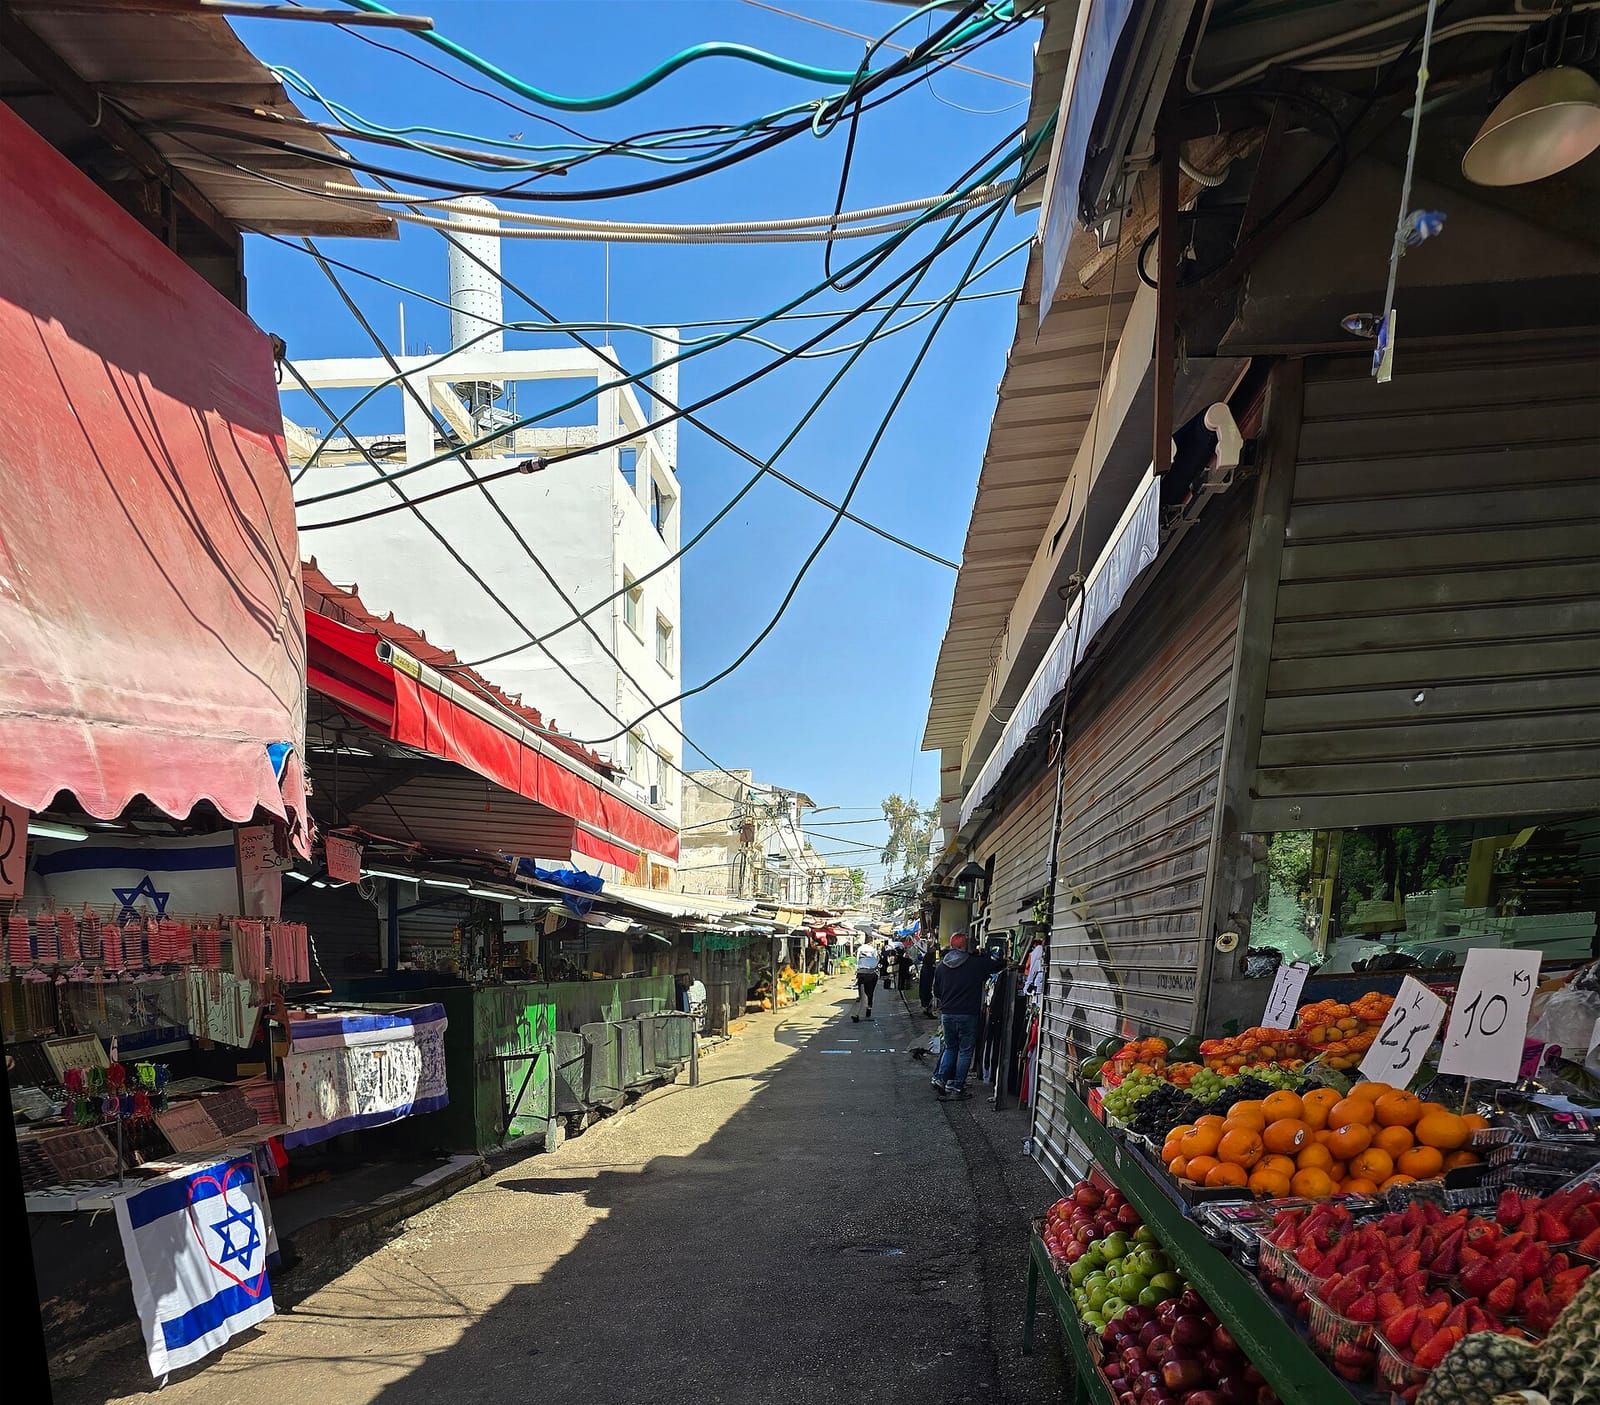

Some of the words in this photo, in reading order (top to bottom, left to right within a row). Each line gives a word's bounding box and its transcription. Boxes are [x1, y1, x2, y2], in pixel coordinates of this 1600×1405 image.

[1268, 983, 1293, 1021] 15
[1512, 970, 1531, 996] Kg
[1464, 991, 1508, 1039] 10
